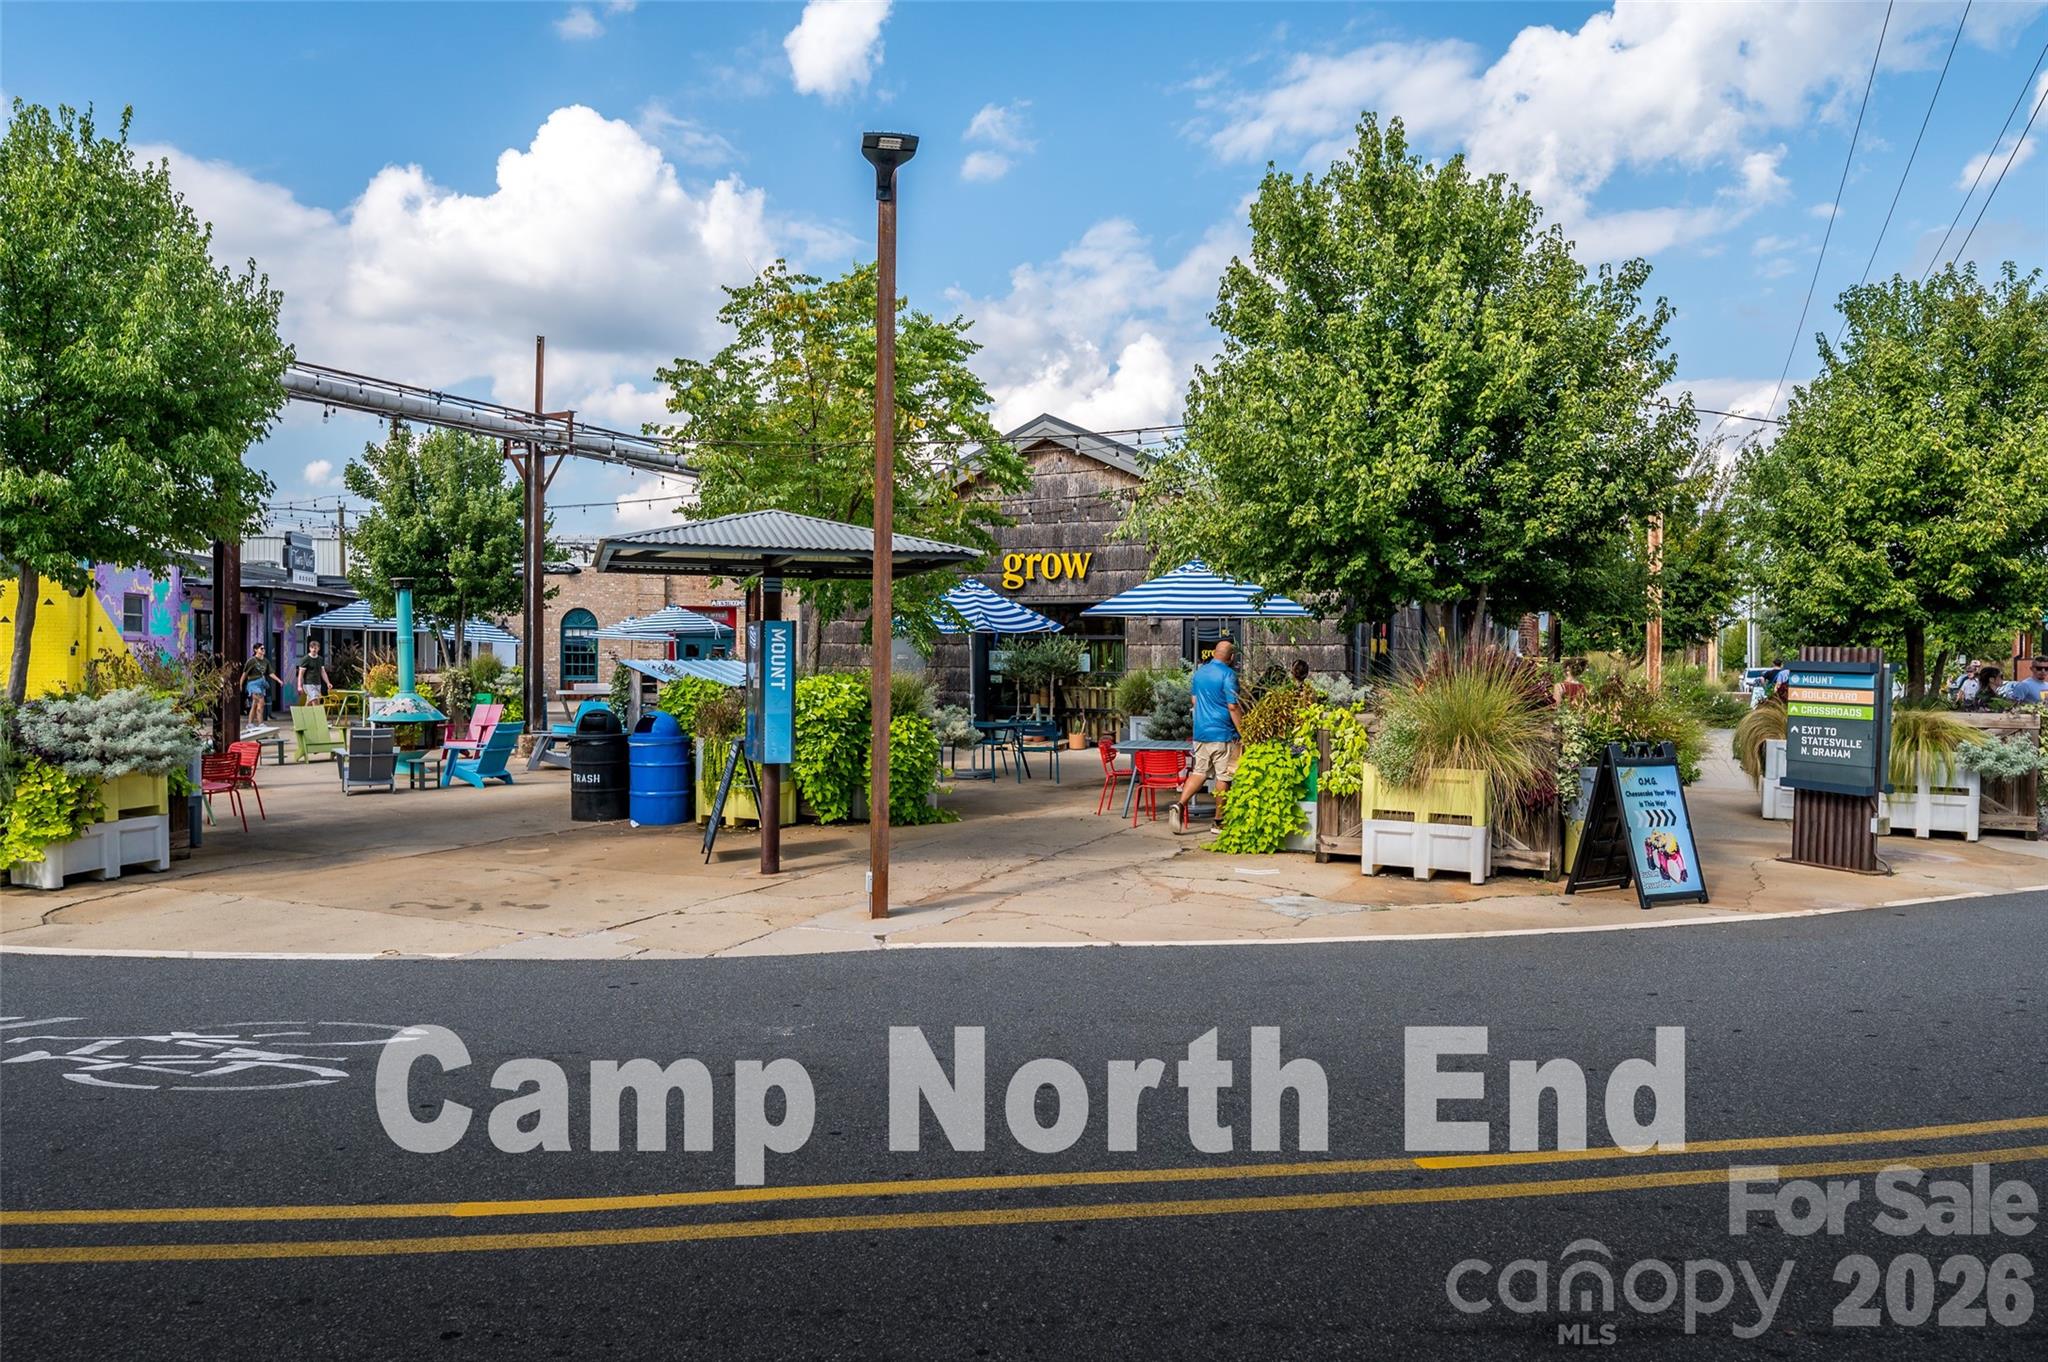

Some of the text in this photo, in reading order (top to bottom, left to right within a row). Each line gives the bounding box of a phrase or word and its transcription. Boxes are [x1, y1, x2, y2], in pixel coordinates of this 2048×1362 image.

[1002, 552, 1092, 590] grow
[770, 628, 786, 690] MOUNT
[1201, 649, 1216, 660] gro
[1802, 675, 1834, 685] MOUNT
[1801, 690, 1858, 701] BOILERYARD
[1801, 705, 1862, 717] CROSSROADS
[1801, 726, 1837, 736] EXIT TO
[1801, 736, 1862, 749] STATESVILLE
[1801, 746, 1851, 759] N. GRAHAM
[573, 773, 600, 783] TRASH
[1666, 789, 1676, 798] Way
